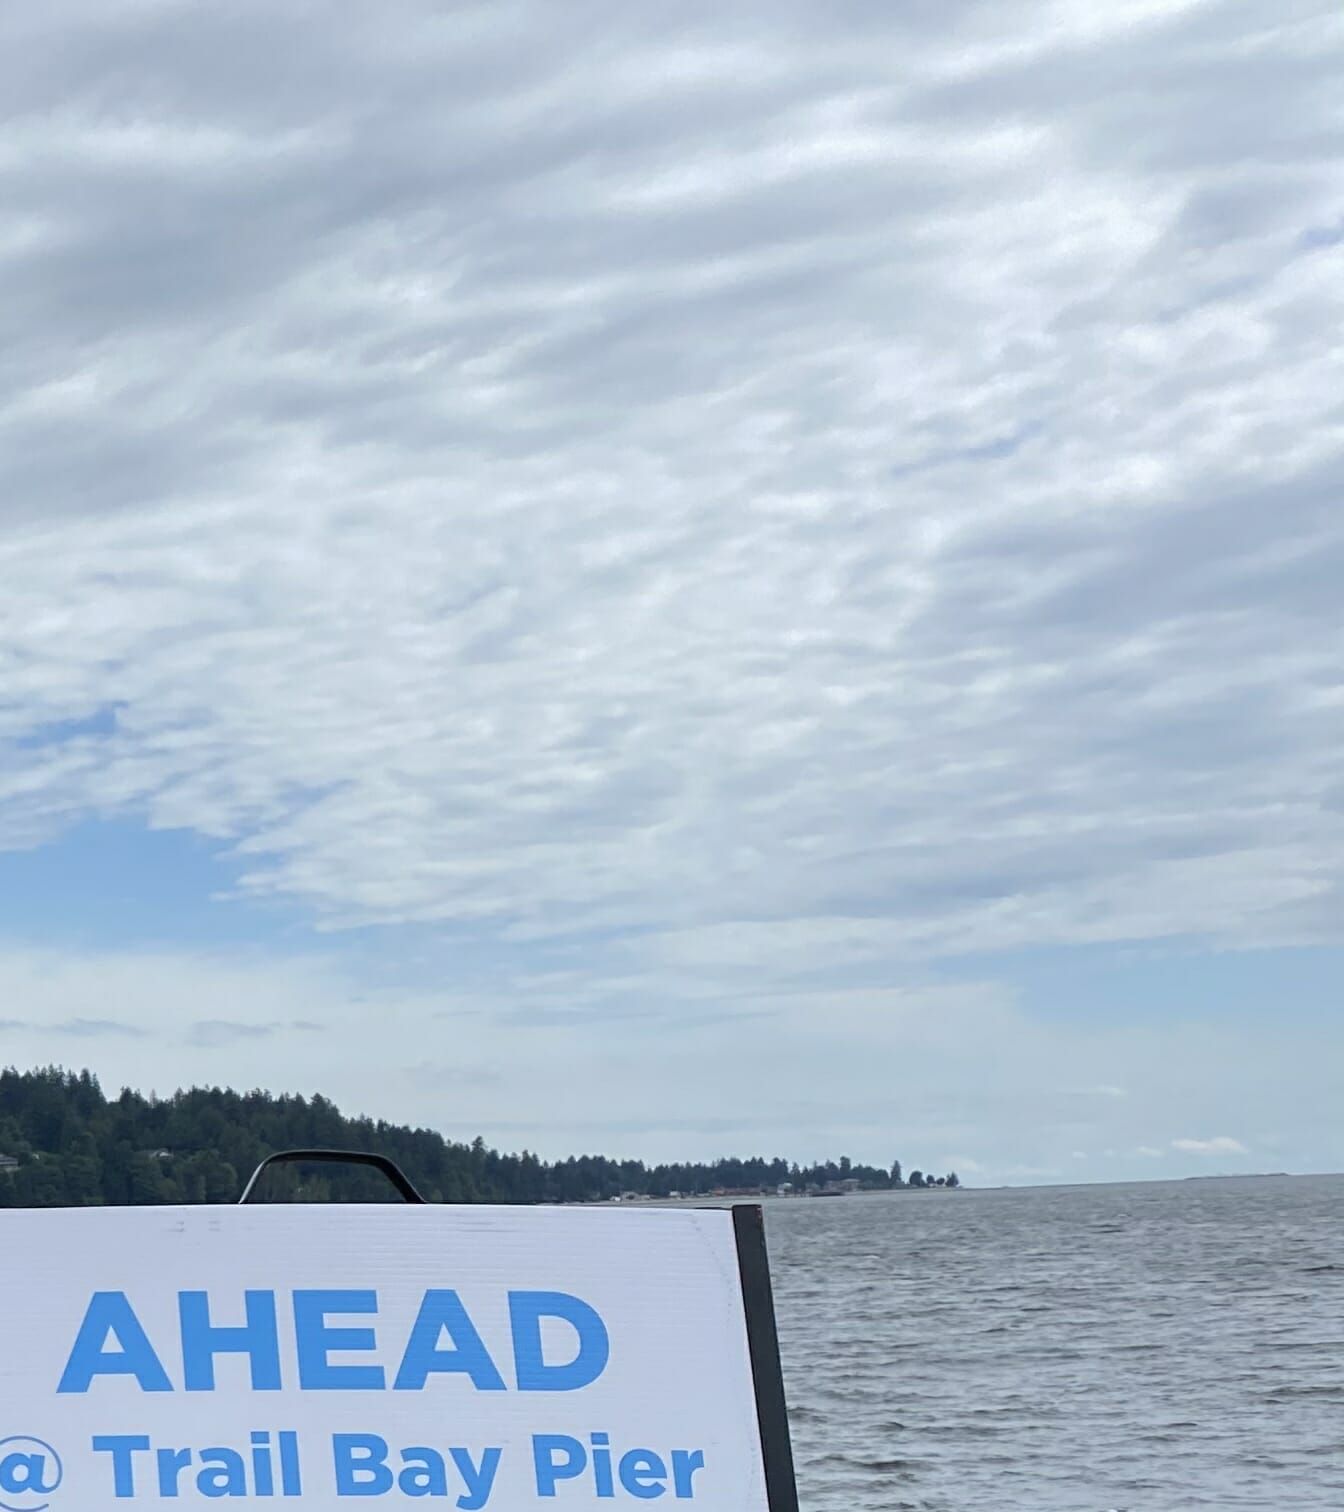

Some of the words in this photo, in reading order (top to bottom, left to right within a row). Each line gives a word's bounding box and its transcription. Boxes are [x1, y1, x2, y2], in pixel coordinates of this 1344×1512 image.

[56, 1288, 610, 1393] AHEAD
[92, 1430, 302, 1499] Trail
[332, 1432, 503, 1511] Bay
[531, 1430, 705, 1499] Pier
